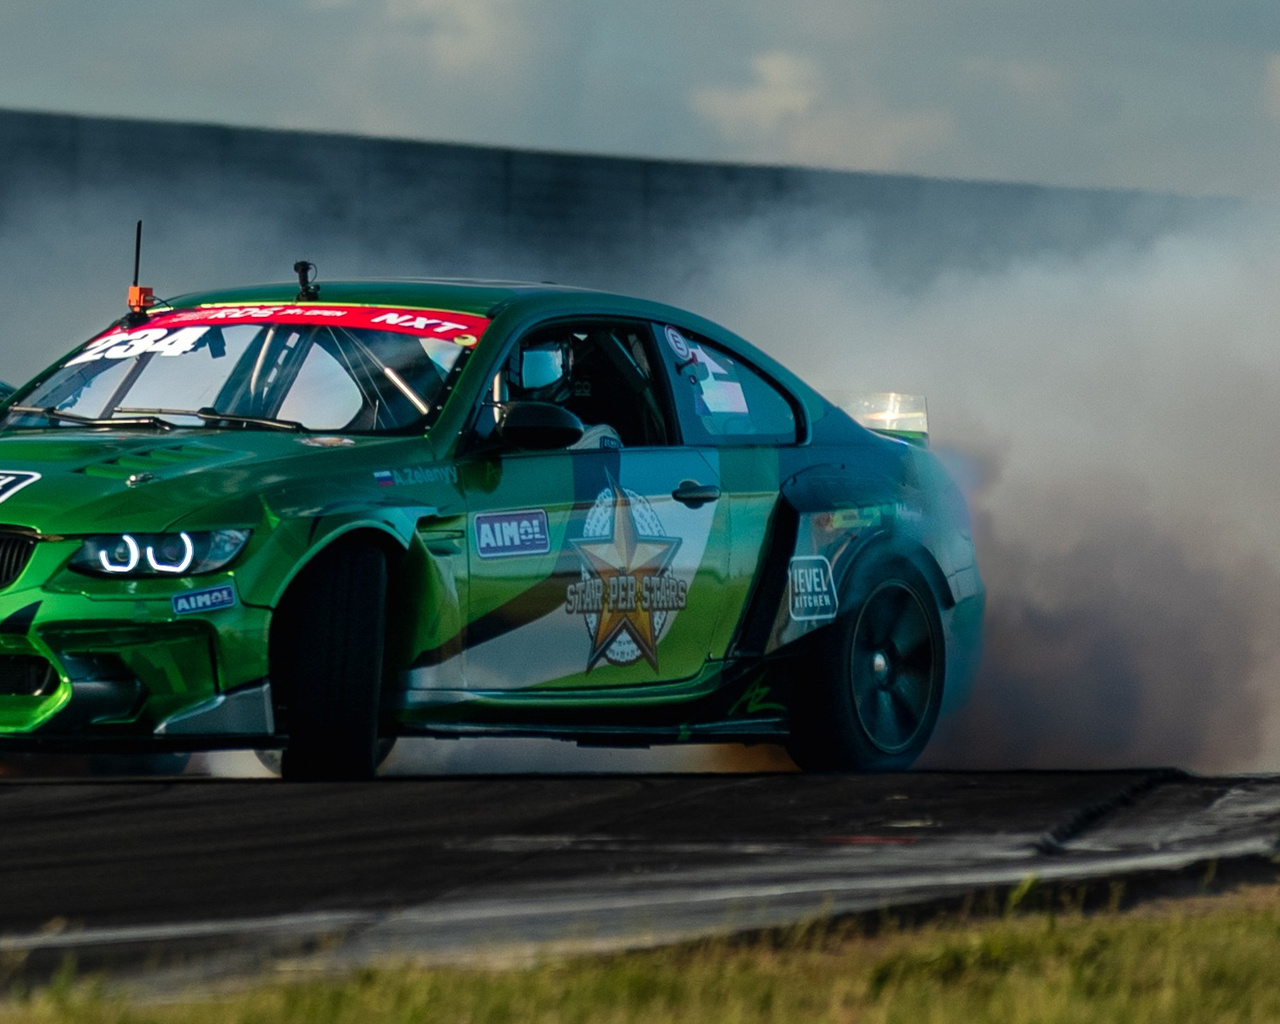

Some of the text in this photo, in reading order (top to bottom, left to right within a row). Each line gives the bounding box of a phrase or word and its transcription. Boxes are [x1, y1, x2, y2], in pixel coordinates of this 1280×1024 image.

[208, 307, 283, 319] RDS
[369, 312, 469, 333] NXT
[63, 326, 210, 368] 234
[479, 519, 546, 548] AIMOL
[793, 568, 829, 592] LEVEL
[177, 589, 232, 611] AIMOL
[566, 576, 687, 612] STAR PER STARS
[794, 594, 831, 608] KITCHEN
